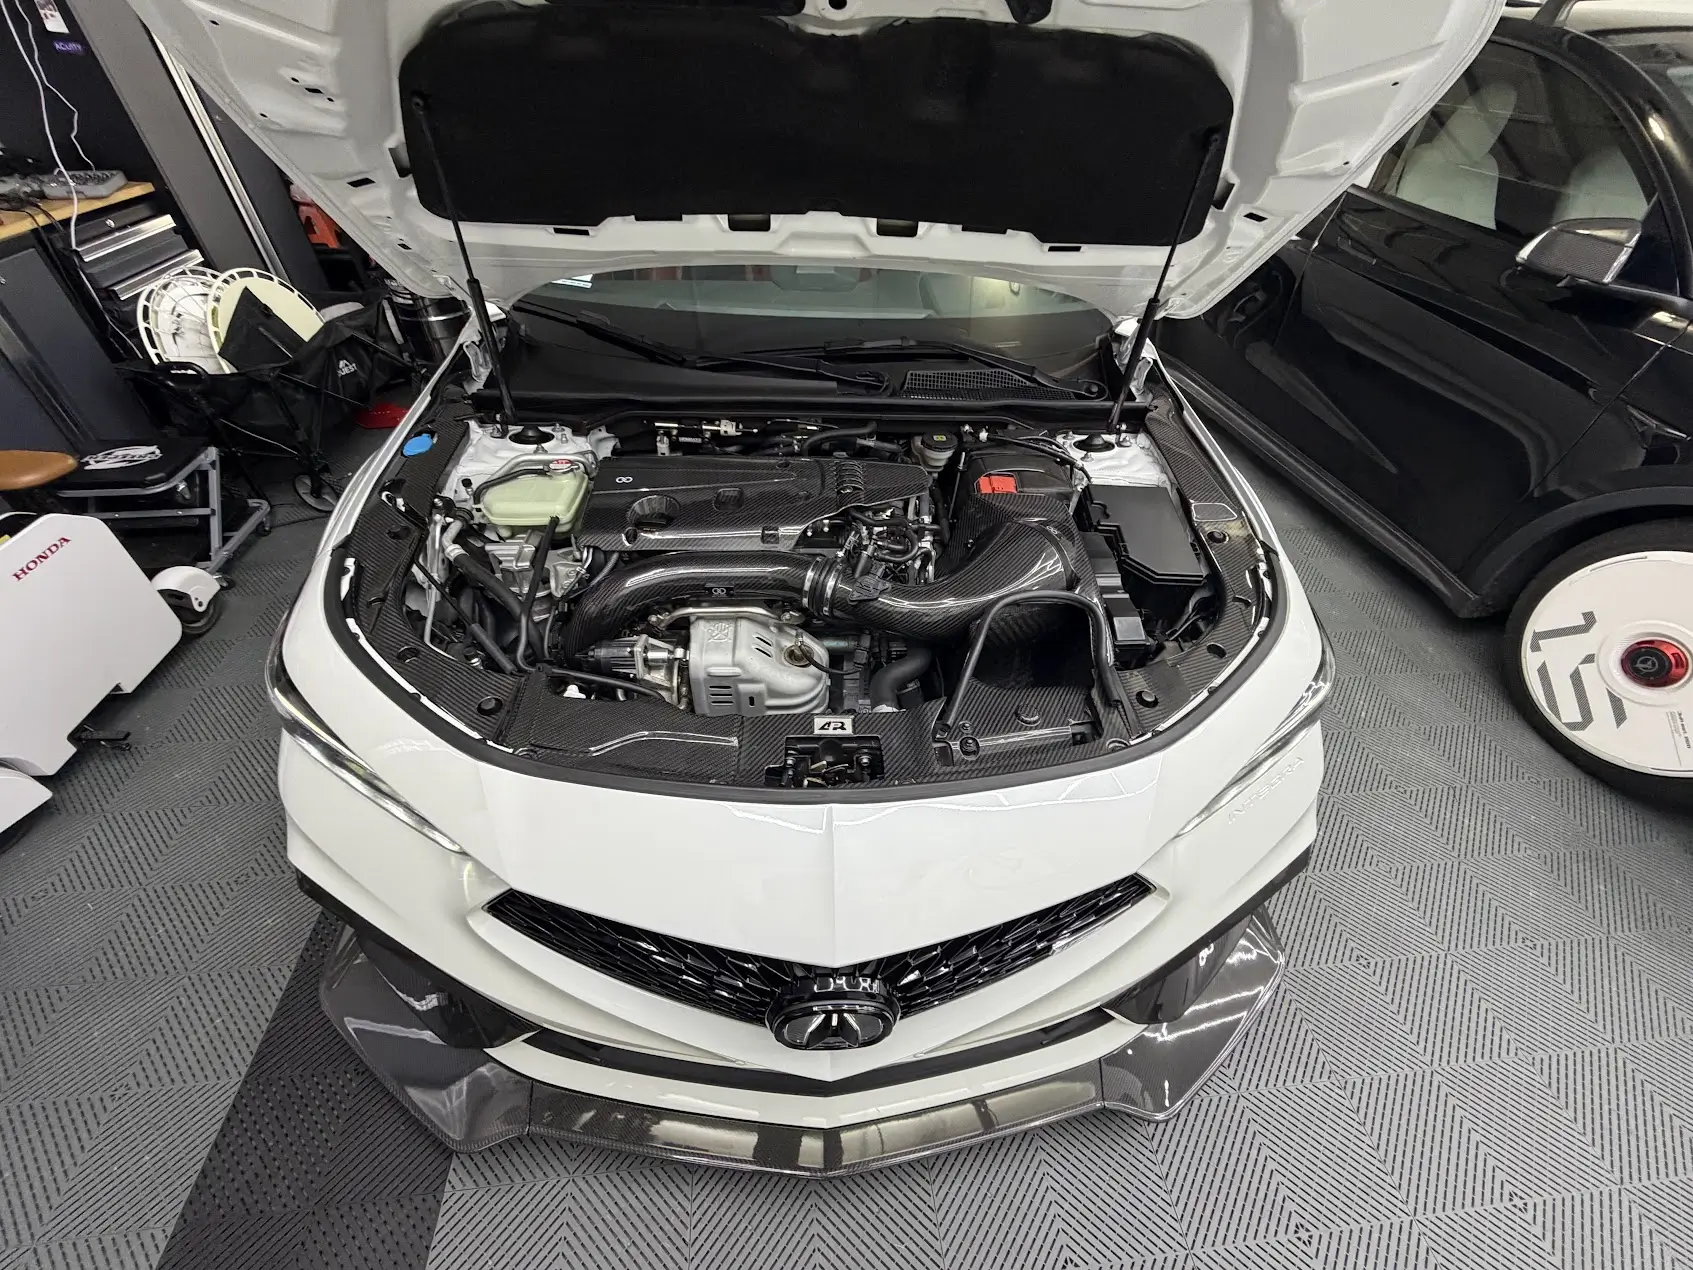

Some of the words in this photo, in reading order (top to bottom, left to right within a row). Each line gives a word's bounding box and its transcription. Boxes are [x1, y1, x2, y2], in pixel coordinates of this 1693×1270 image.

[12, 536, 72, 581] HONDA
[818, 721, 847, 731] AR
[1228, 756, 1305, 825] INTEGRA
